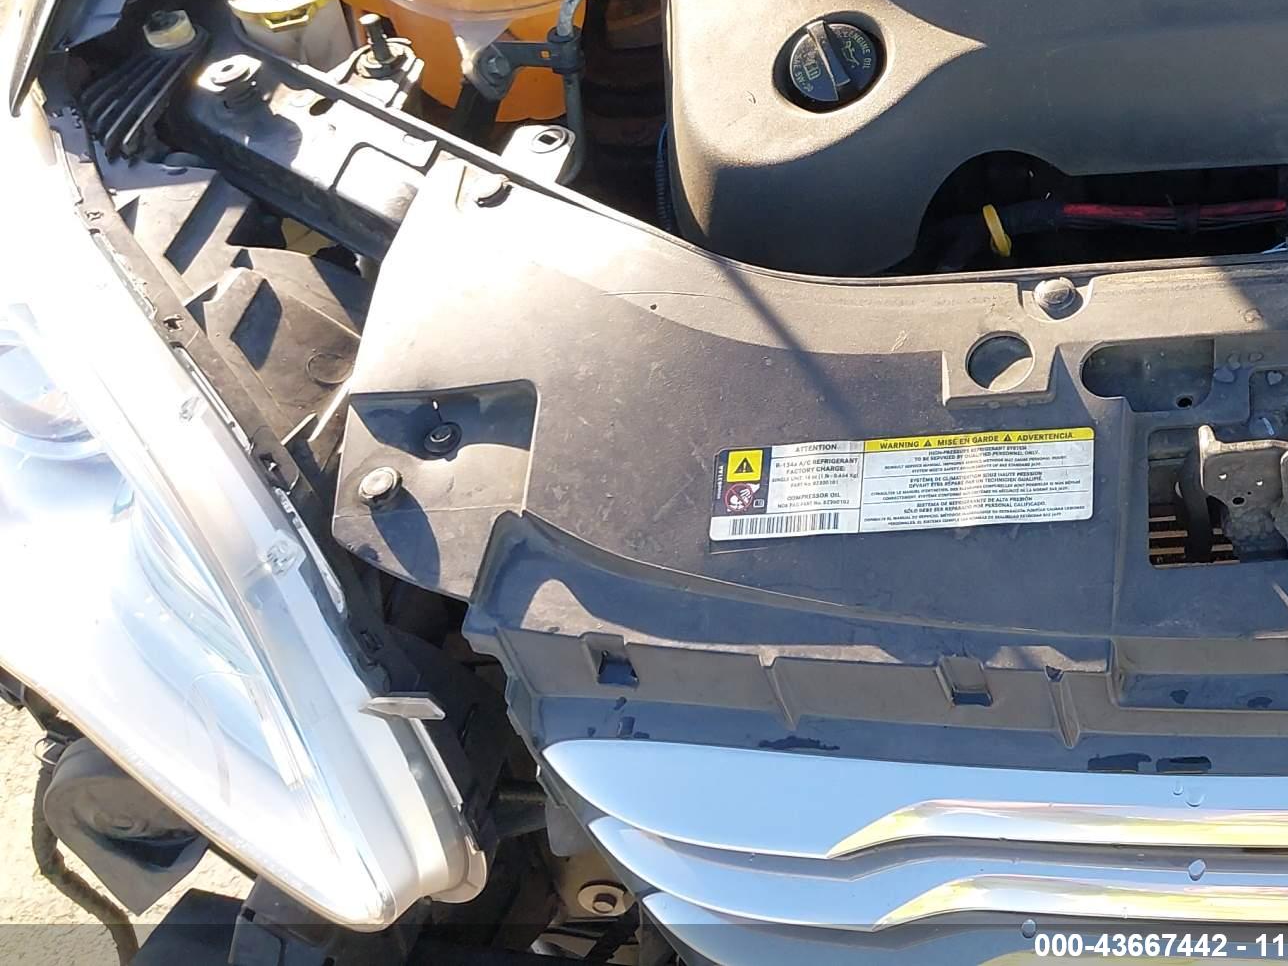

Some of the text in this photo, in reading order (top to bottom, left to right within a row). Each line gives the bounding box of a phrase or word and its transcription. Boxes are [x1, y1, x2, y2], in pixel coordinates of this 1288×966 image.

[850, 30, 872, 69] ENGINE OIL
[880, 440, 919, 449] WARNING
[937, 438, 959, 446] MISE
[972, 435, 999, 443] GARDE
[1017, 432, 1073, 442] ADVERTENCIA
[796, 443, 837, 452] ATTENTION
[812, 457, 859, 465] REFRIGERANT
[787, 493, 829, 501] COMPRESSOR
